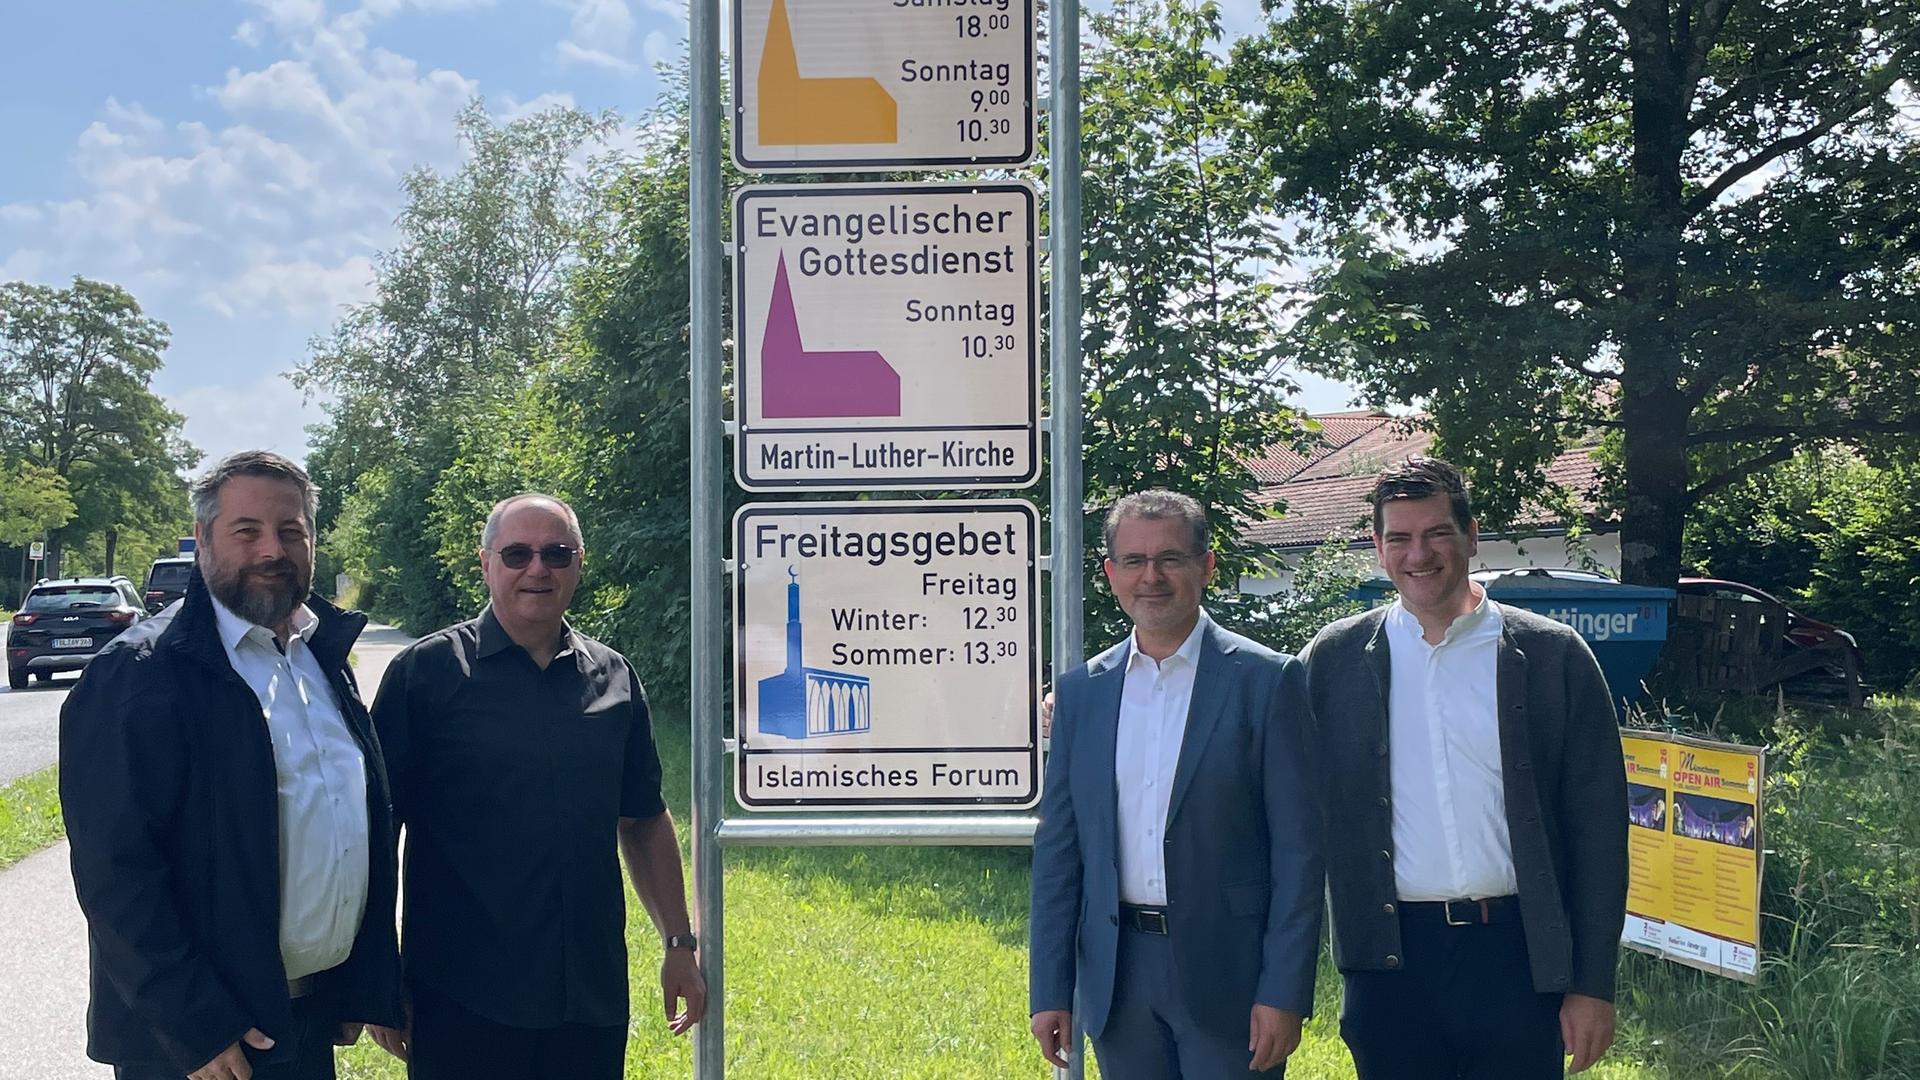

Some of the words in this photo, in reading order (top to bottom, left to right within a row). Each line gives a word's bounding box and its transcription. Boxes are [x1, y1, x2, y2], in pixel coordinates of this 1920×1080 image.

[901, 59, 1010, 86] Sonntag
[757, 204, 1013, 244] Evangelischer
[799, 245, 1014, 276] Gottesdienst
[905, 299, 1015, 326] Sonntag
[761, 440, 1014, 470] Martin-Luther-Kirche
[756, 522, 1016, 566] Freitagsgebet
[922, 572, 1017, 601] Freitag
[831, 608, 928, 631] Winter:
[1522, 607, 1638, 641] ttinger
[831, 642, 954, 666] Sommer:
[758, 764, 918, 788] Islamisches
[932, 763, 1019, 787] Forum
[1673, 771, 1702, 786] OPEN
[1703, 774, 1721, 788] AIR
